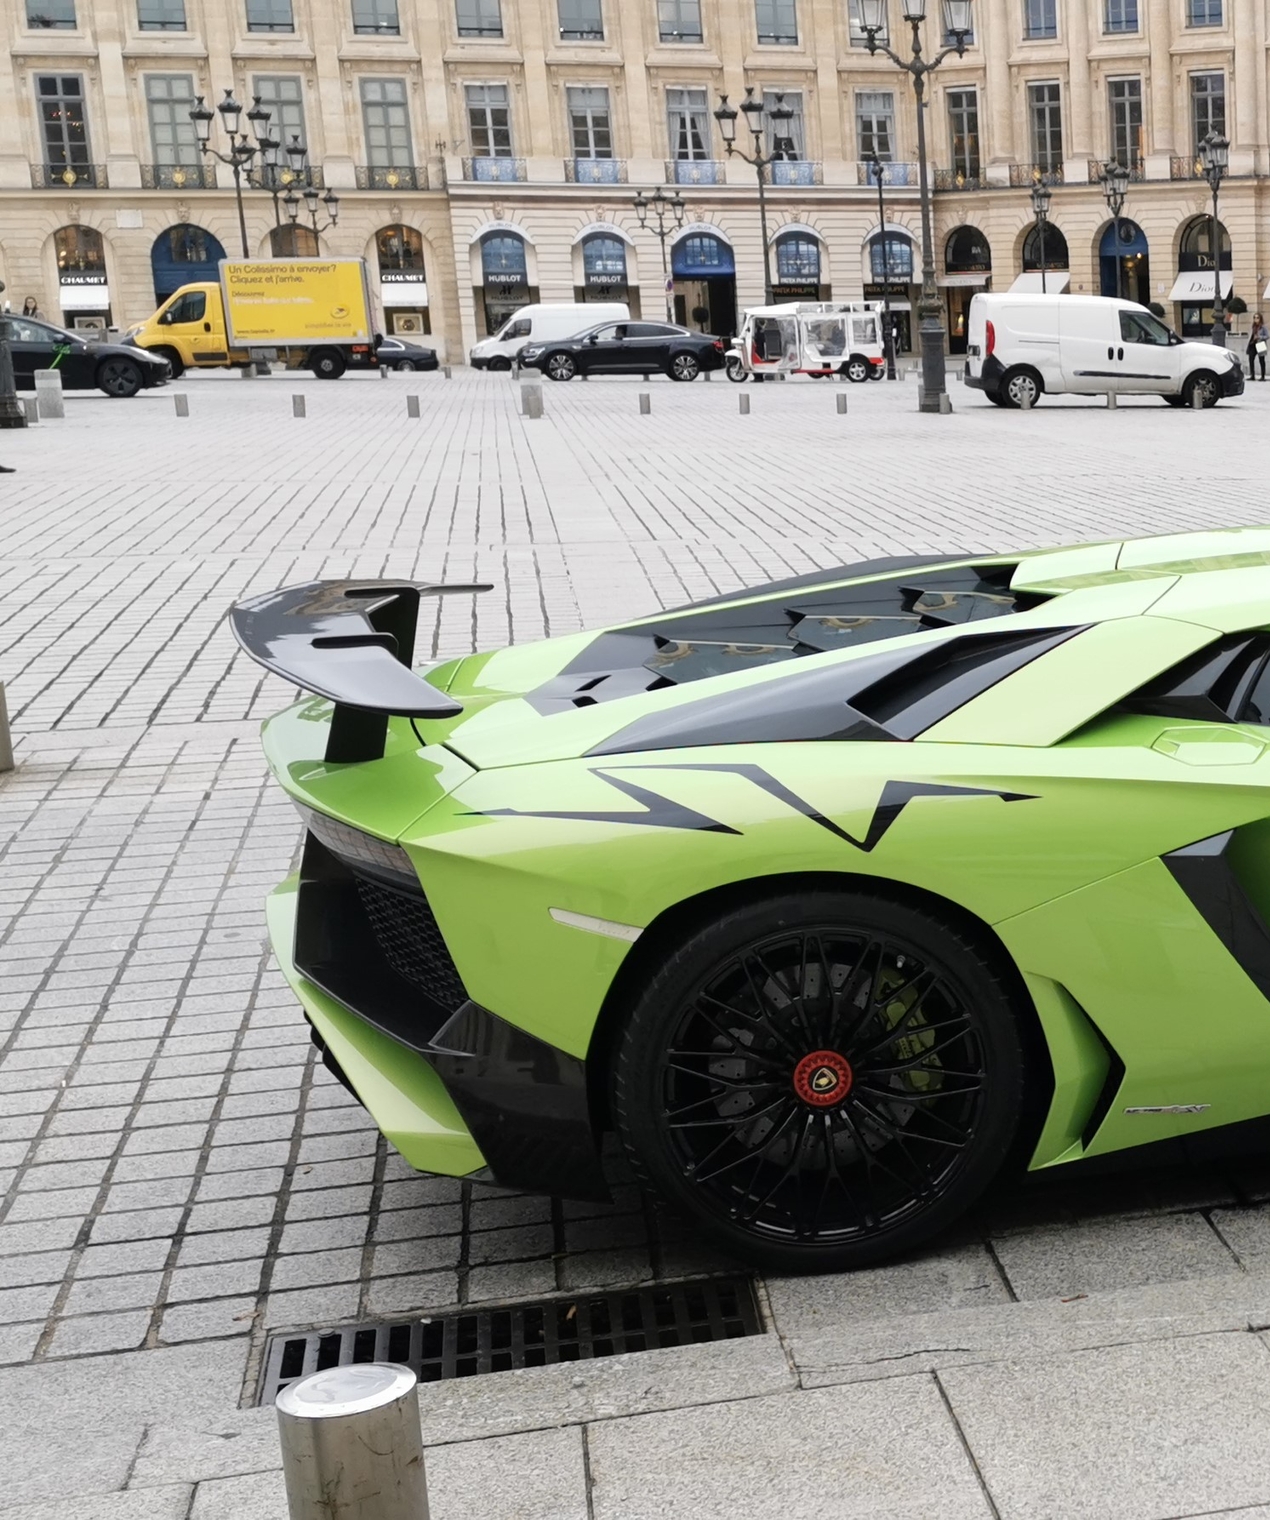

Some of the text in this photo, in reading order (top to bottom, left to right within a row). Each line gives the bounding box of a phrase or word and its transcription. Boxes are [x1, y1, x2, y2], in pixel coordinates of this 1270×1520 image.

[1197, 254, 1215, 267] Dio
[229, 264, 337, 274] Un Colissimo à envoyer?
[61, 276, 105, 284] CHAUMET
[230, 275, 263, 285] Cliquez
[265, 275, 273, 283] et
[488, 274, 521, 282] HUBLOT
[590, 275, 621, 283] HUBLOT
